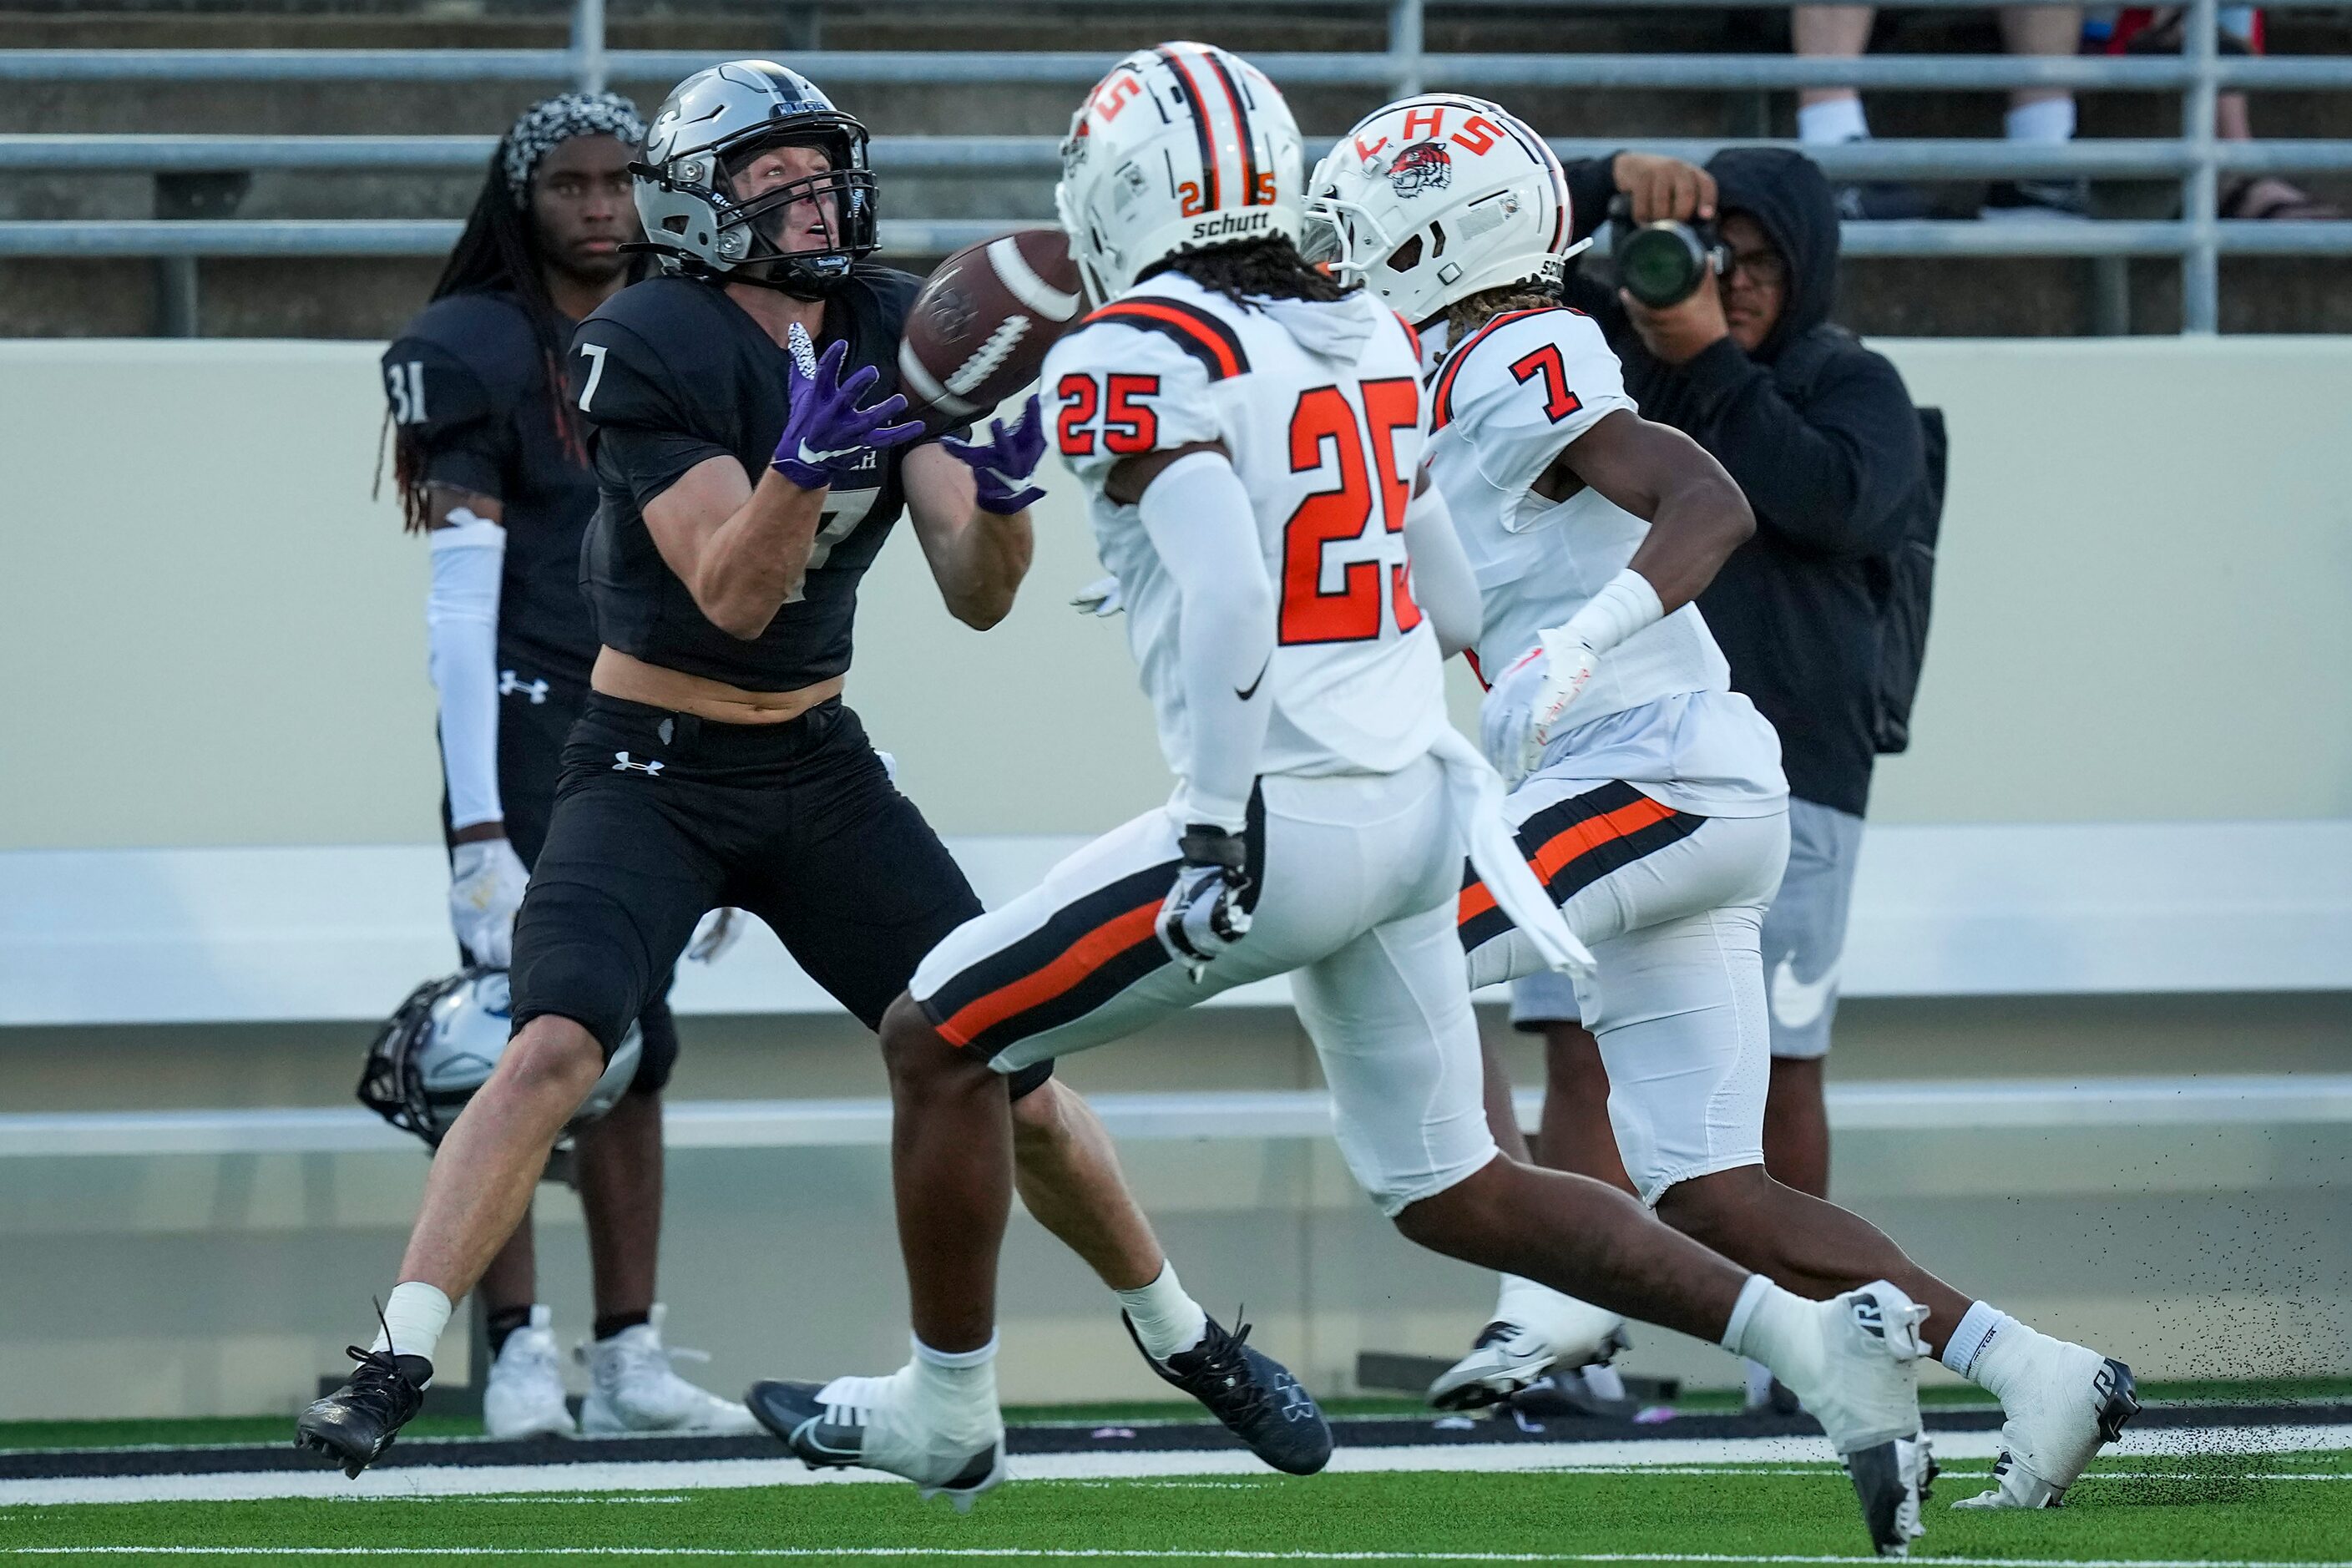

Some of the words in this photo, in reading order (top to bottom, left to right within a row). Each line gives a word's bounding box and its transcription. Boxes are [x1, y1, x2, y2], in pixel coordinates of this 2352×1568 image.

[387, 361, 427, 426] 31
[579, 342, 608, 412] 7
[1057, 372, 1160, 456] 25
[1508, 342, 1583, 425] 7
[1278, 377, 1423, 646] 25
